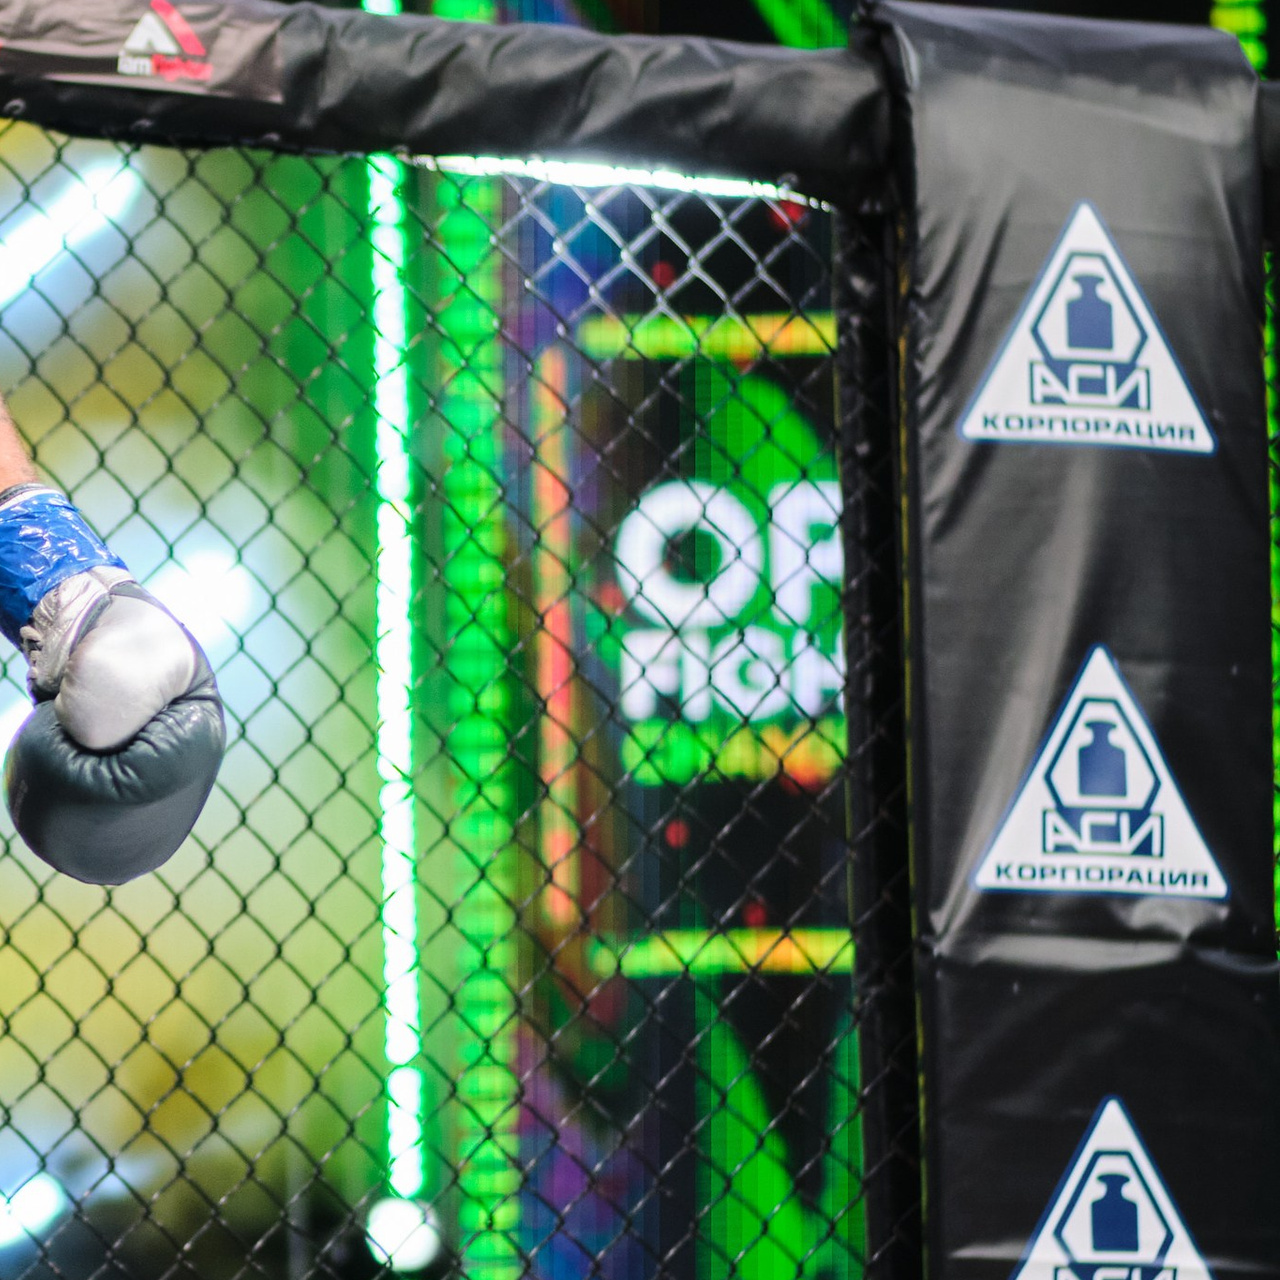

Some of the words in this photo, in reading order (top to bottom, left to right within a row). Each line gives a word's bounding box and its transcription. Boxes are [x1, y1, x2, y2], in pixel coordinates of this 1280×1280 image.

[1032, 363, 1150, 410] АСИ
[982, 412, 1195, 442] КОРПОРАЦИЯ
[1045, 810, 1163, 856] АСИ
[995, 862, 1209, 890] КОРПОРАЦИЯ
